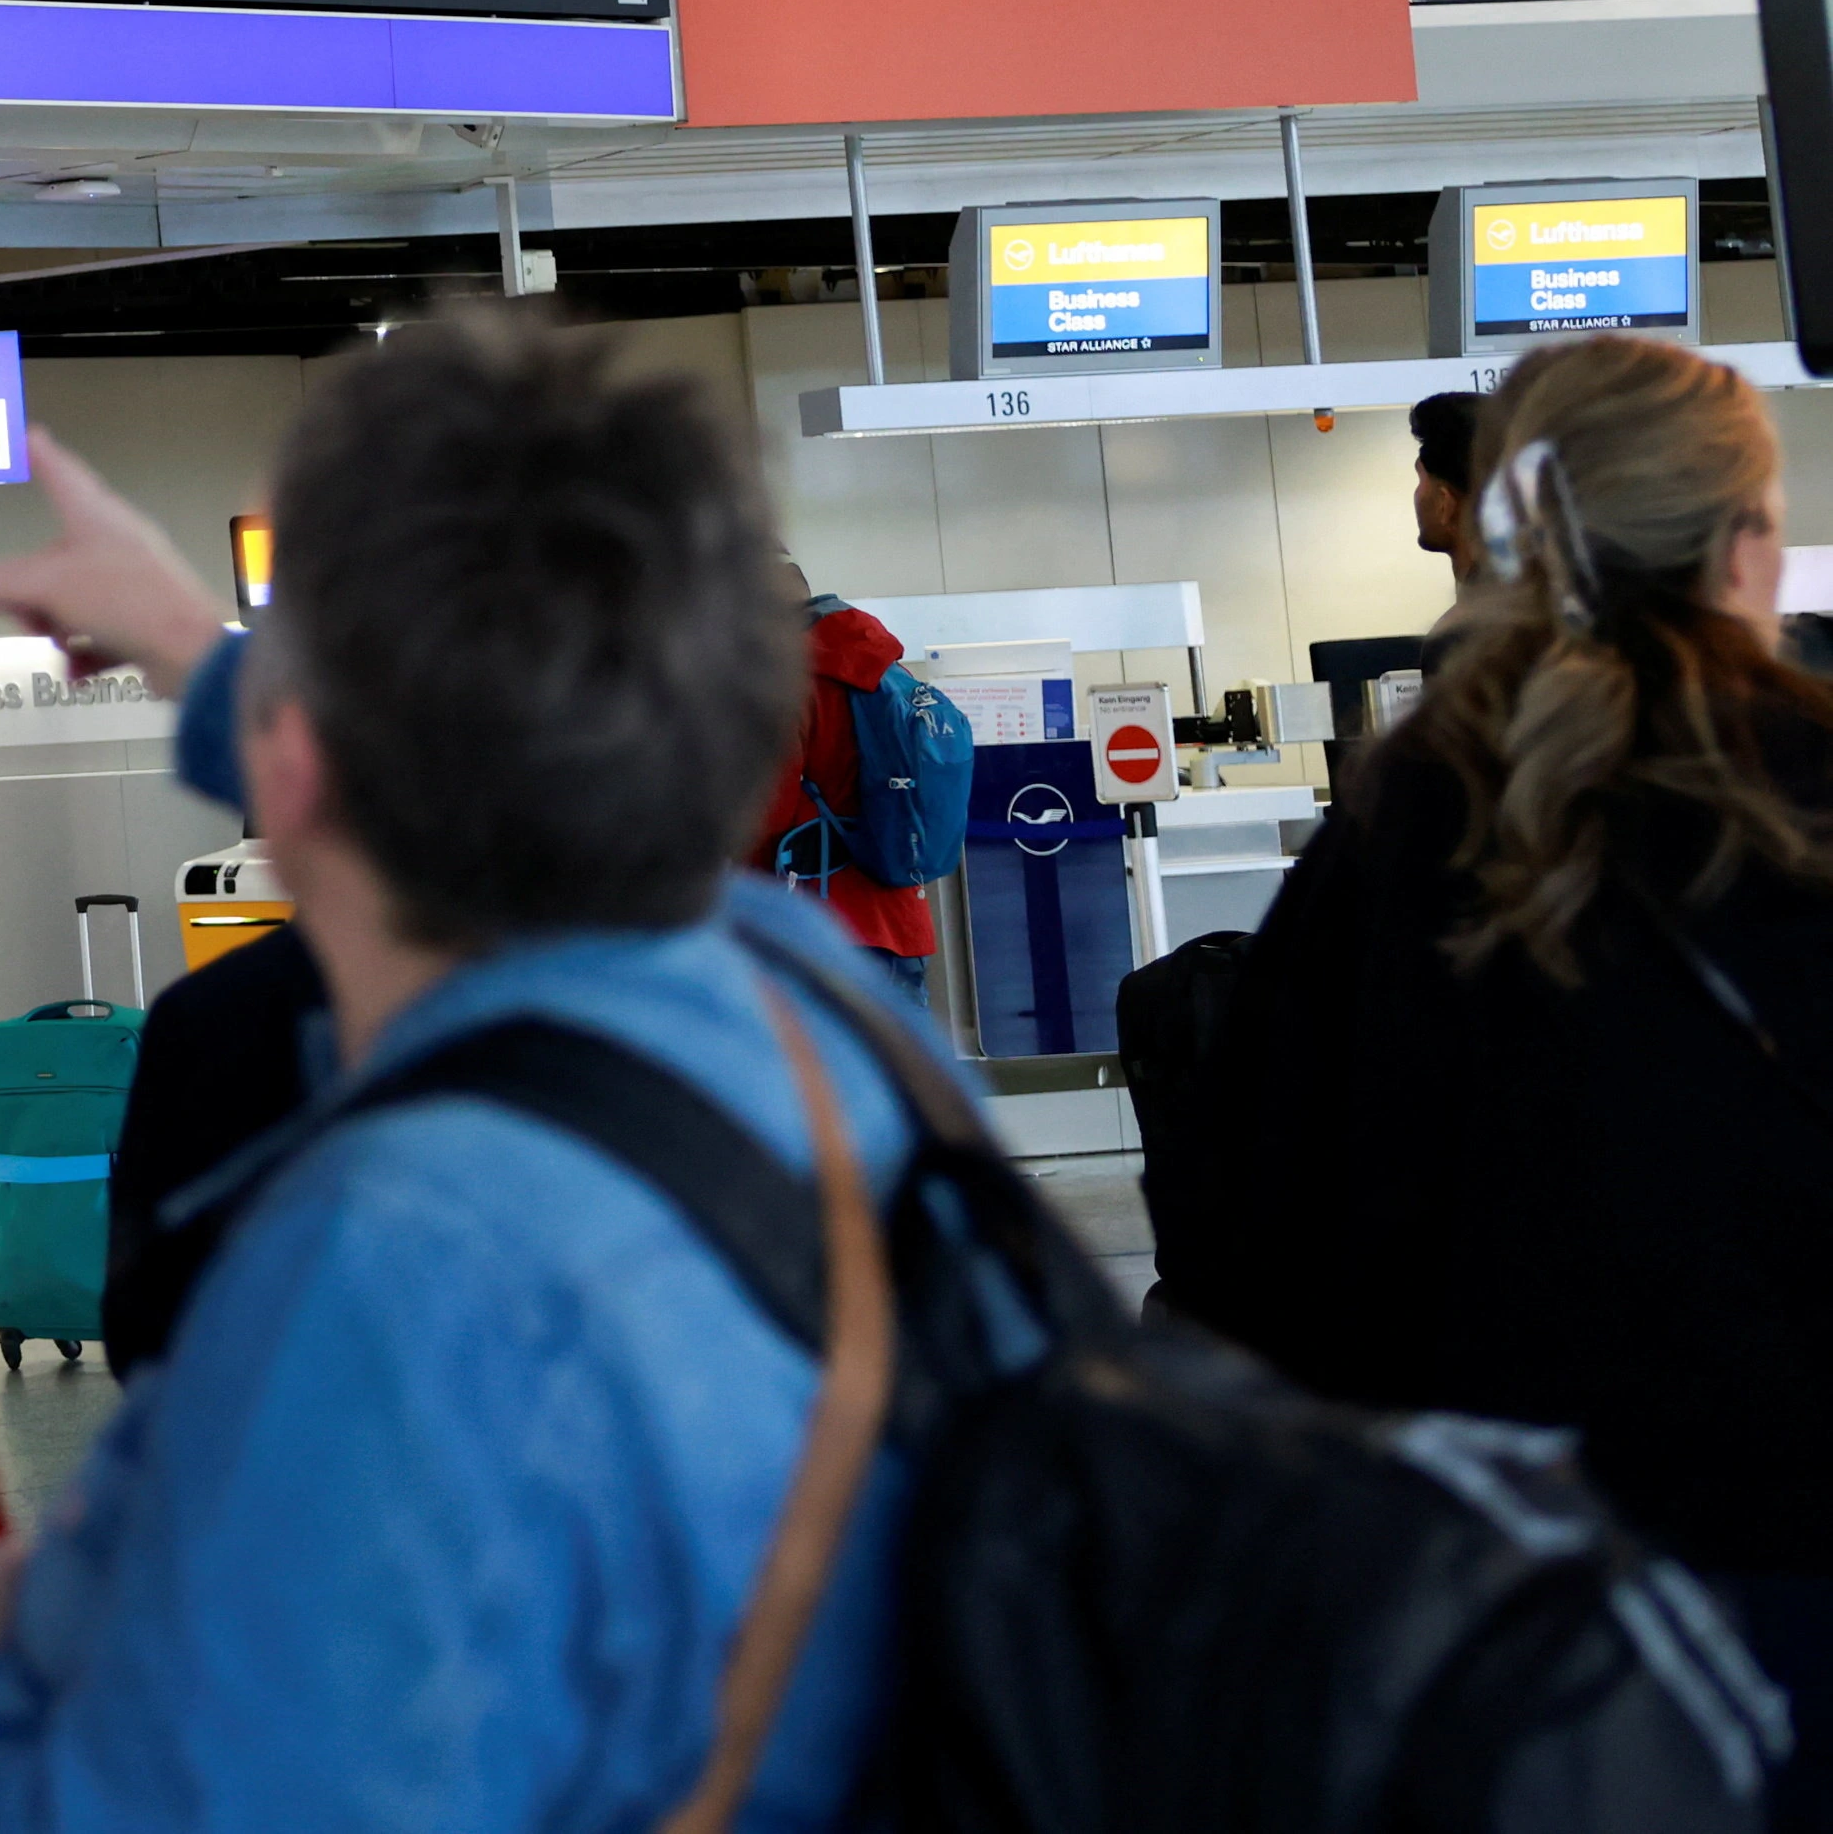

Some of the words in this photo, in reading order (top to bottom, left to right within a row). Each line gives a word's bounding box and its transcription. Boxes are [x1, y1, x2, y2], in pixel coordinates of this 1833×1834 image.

[1530, 221, 1644, 244] Lufthansa
[1048, 240, 1165, 265] Lufthansa
[1531, 269, 1621, 289] Business
[1049, 289, 1140, 311] Business
[1531, 291, 1586, 311] Class
[1049, 312, 1106, 332] Class
[1530, 318, 1559, 331] STAR
[1562, 316, 1618, 330] ALLIANCE
[1047, 340, 1077, 353] STAR
[1080, 337, 1138, 351] ALLIANCE
[986, 391, 1030, 417] 136
[1098, 696, 1117, 705] Kein
[1118, 695, 1151, 706] Eingang
